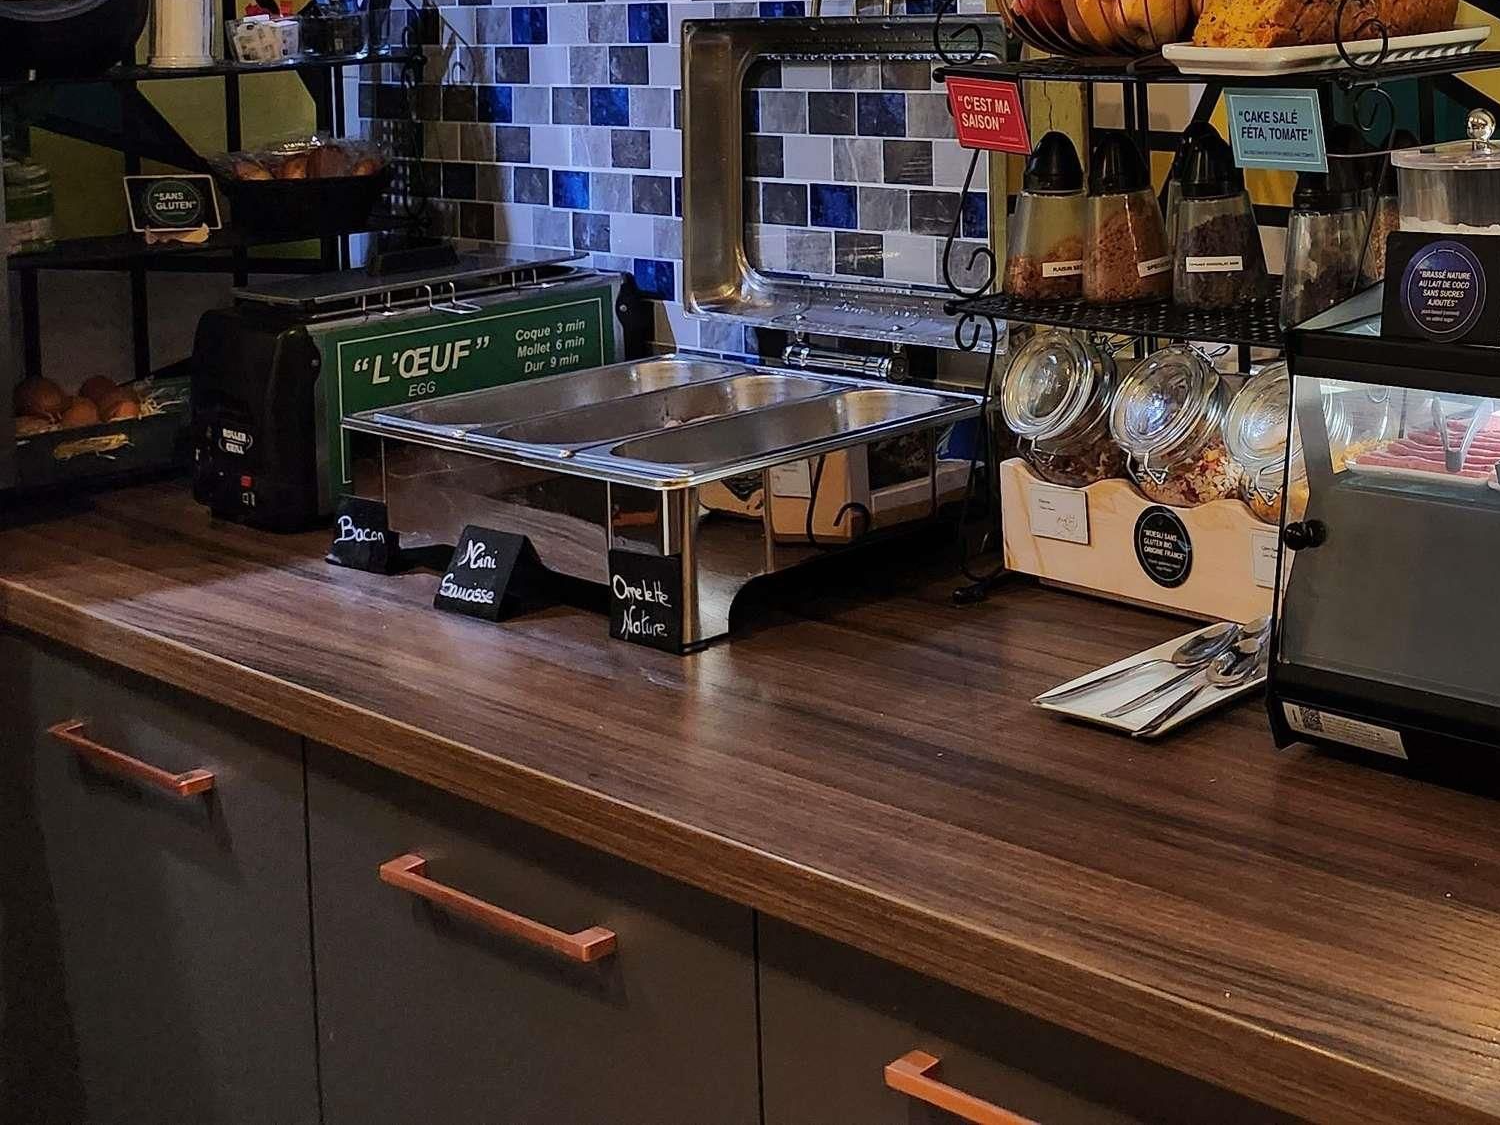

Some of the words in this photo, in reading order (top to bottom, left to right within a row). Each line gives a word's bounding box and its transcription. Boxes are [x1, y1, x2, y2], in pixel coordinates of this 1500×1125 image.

[957, 95, 992, 113] "C'EST
[994, 98, 1011, 114] MA
[961, 112, 1005, 131] SAISON"
[1239, 110, 1270, 123] "CAKE
[1272, 108, 1298, 124] SALÉ
[1241, 124, 1268, 141] FÉTA,
[1269, 127, 1313, 141] TOMATE"
[1419, 280, 1428, 288] AU
[1428, 280, 1442, 288] LAIT
[1452, 281, 1470, 289] COCO
[1446, 272, 1471, 280] NATURE
[1422, 289, 1439, 297] SANS
[1440, 290, 1464, 298] SUCRES
[515, 327, 551, 342] Coque
[556, 322, 563, 334] 3
[565, 319, 585, 332] min
[517, 341, 551, 358] Mollet
[556, 338, 563, 350] 6
[565, 336, 585, 349] min
[525, 361, 545, 373] Dur
[550, 356, 557, 368] 9
[560, 353, 579, 366] min
[408, 381, 436, 397] EGG
[334, 515, 385, 545] Bacon
